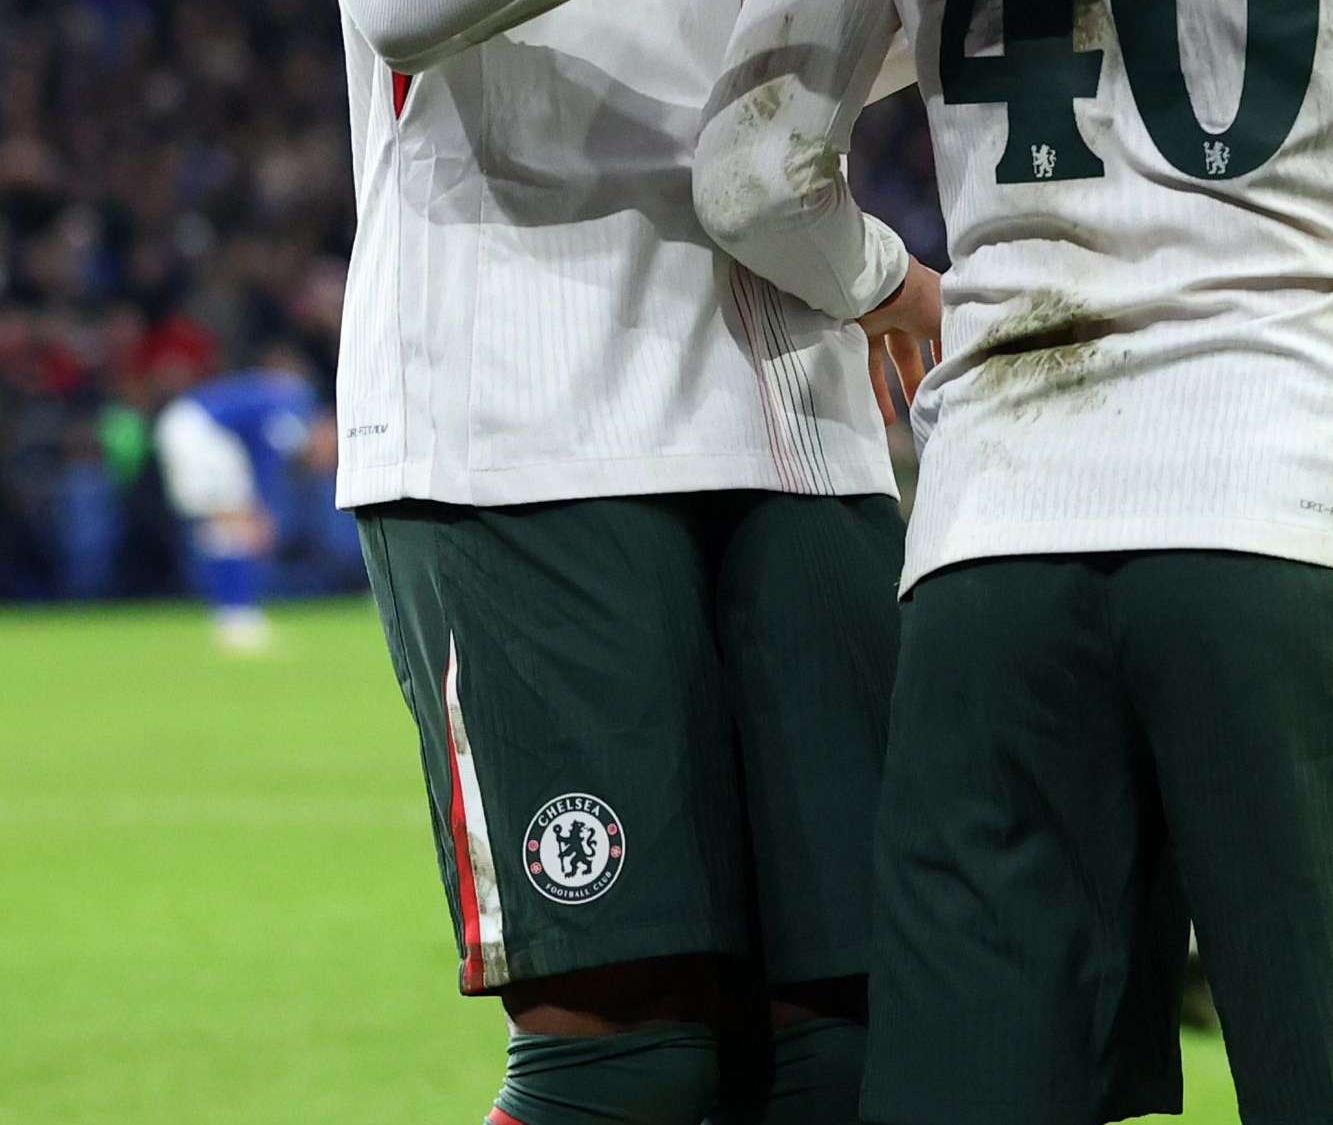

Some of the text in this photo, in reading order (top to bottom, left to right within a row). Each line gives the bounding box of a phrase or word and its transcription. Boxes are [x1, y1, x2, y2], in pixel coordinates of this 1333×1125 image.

[538, 798, 600, 827] CHELSEA
[545, 872, 612, 898] FOOTBALL CLUB
